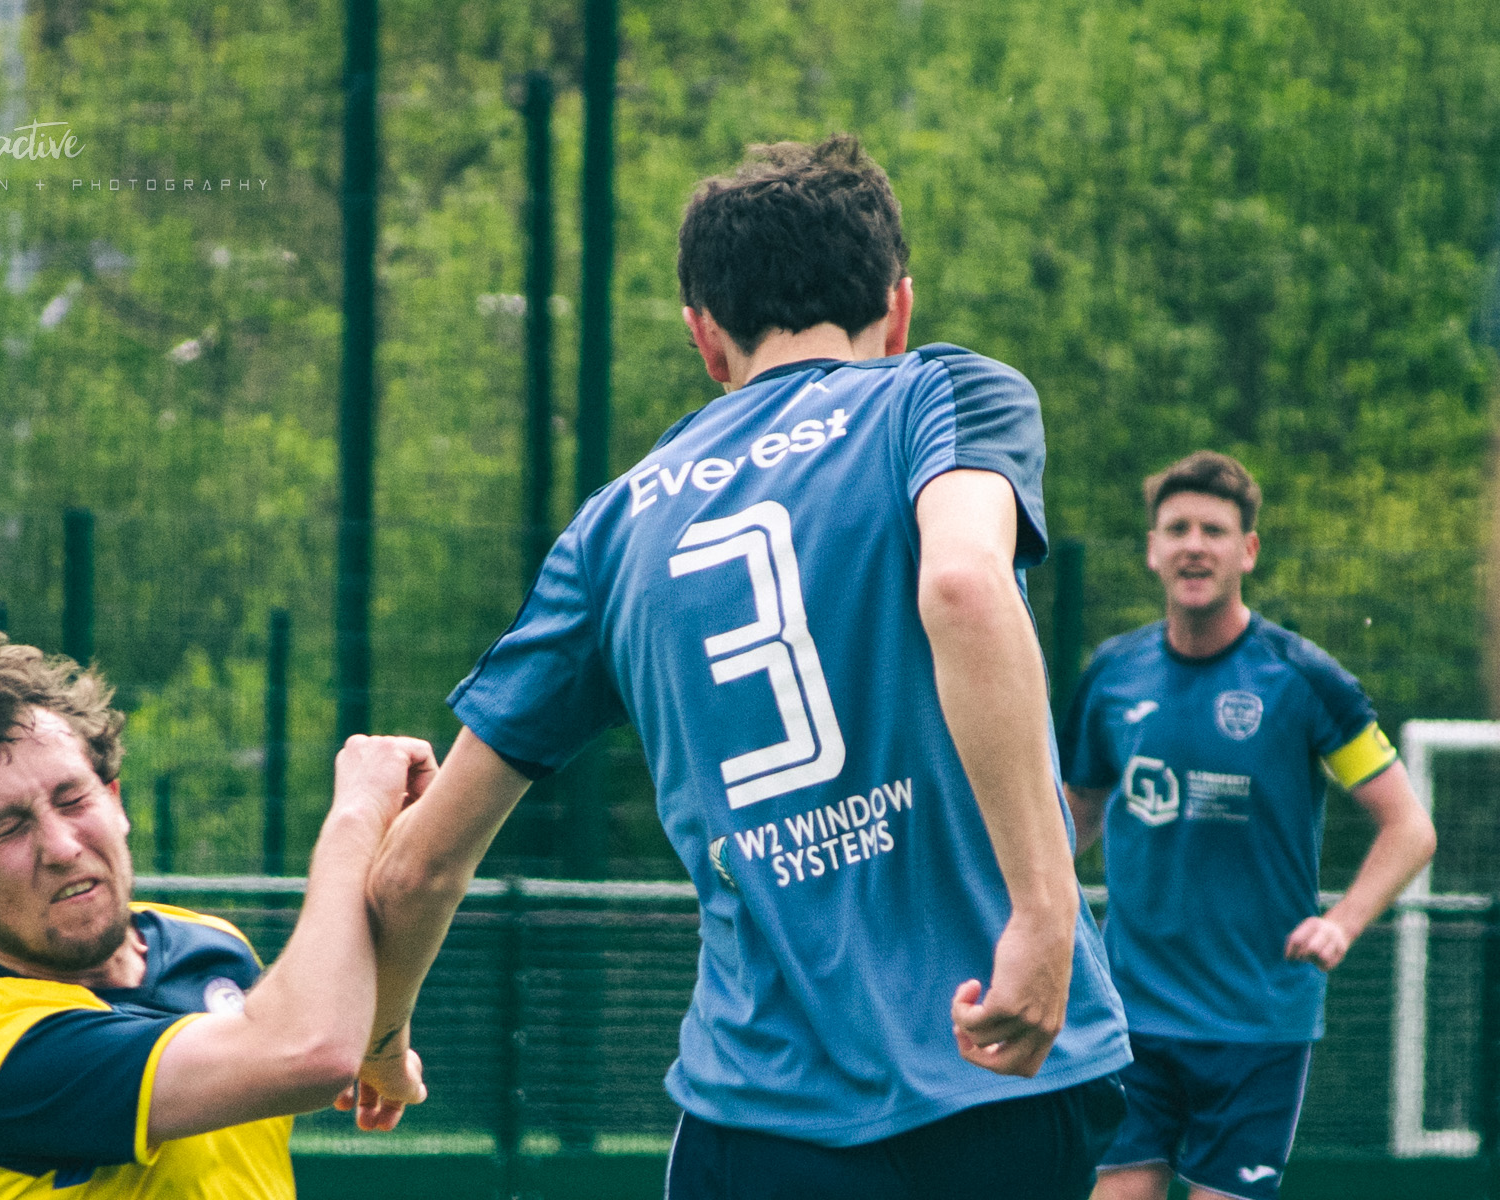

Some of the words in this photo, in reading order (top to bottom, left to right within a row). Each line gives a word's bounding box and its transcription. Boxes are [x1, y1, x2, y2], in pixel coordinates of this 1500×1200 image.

[668, 500, 847, 810] 3
[734, 822, 784, 861] W2
[784, 777, 913, 847] WINDOW
[771, 819, 895, 888] SYSTEMS
